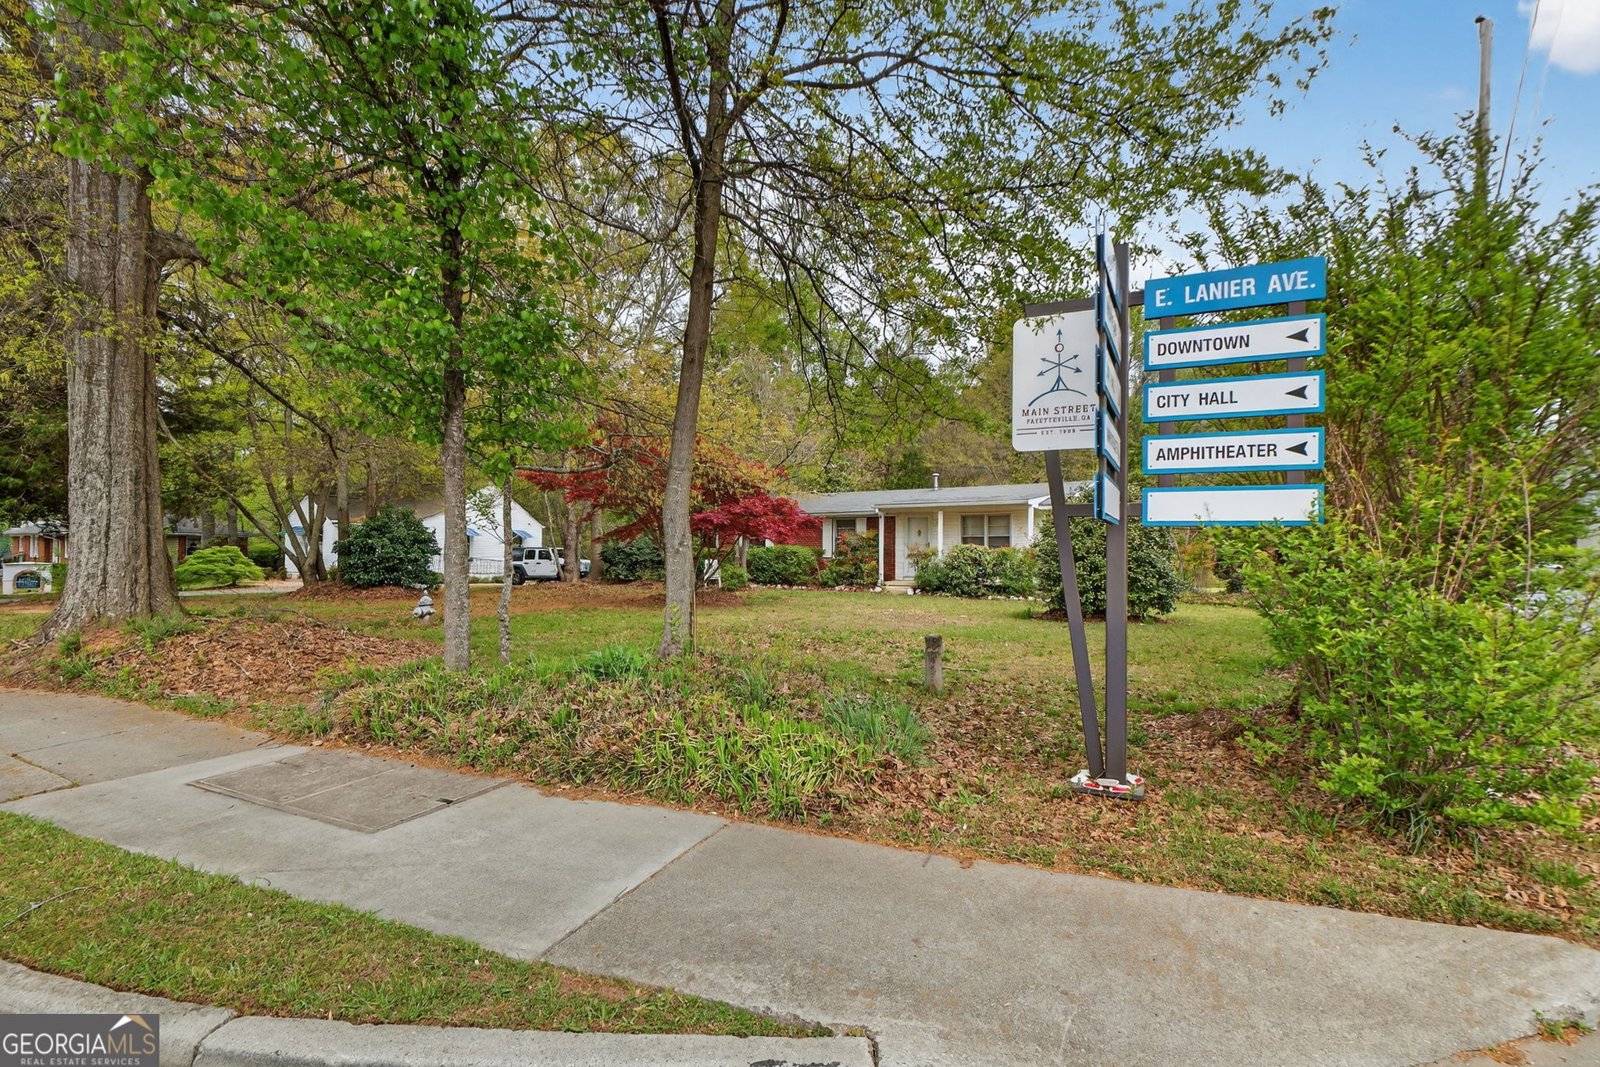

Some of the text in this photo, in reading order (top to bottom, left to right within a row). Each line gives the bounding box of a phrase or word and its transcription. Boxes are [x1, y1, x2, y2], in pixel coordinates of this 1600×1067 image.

[1155, 270, 1316, 307] E. LANIER AVE.
[1157, 334, 1250, 356] DOWNTOWN
[1156, 390, 1238, 408] CITY HALL
[1022, 403, 1096, 417] MAIN STREET
[1156, 443, 1277, 461] AMPHITHEATER
